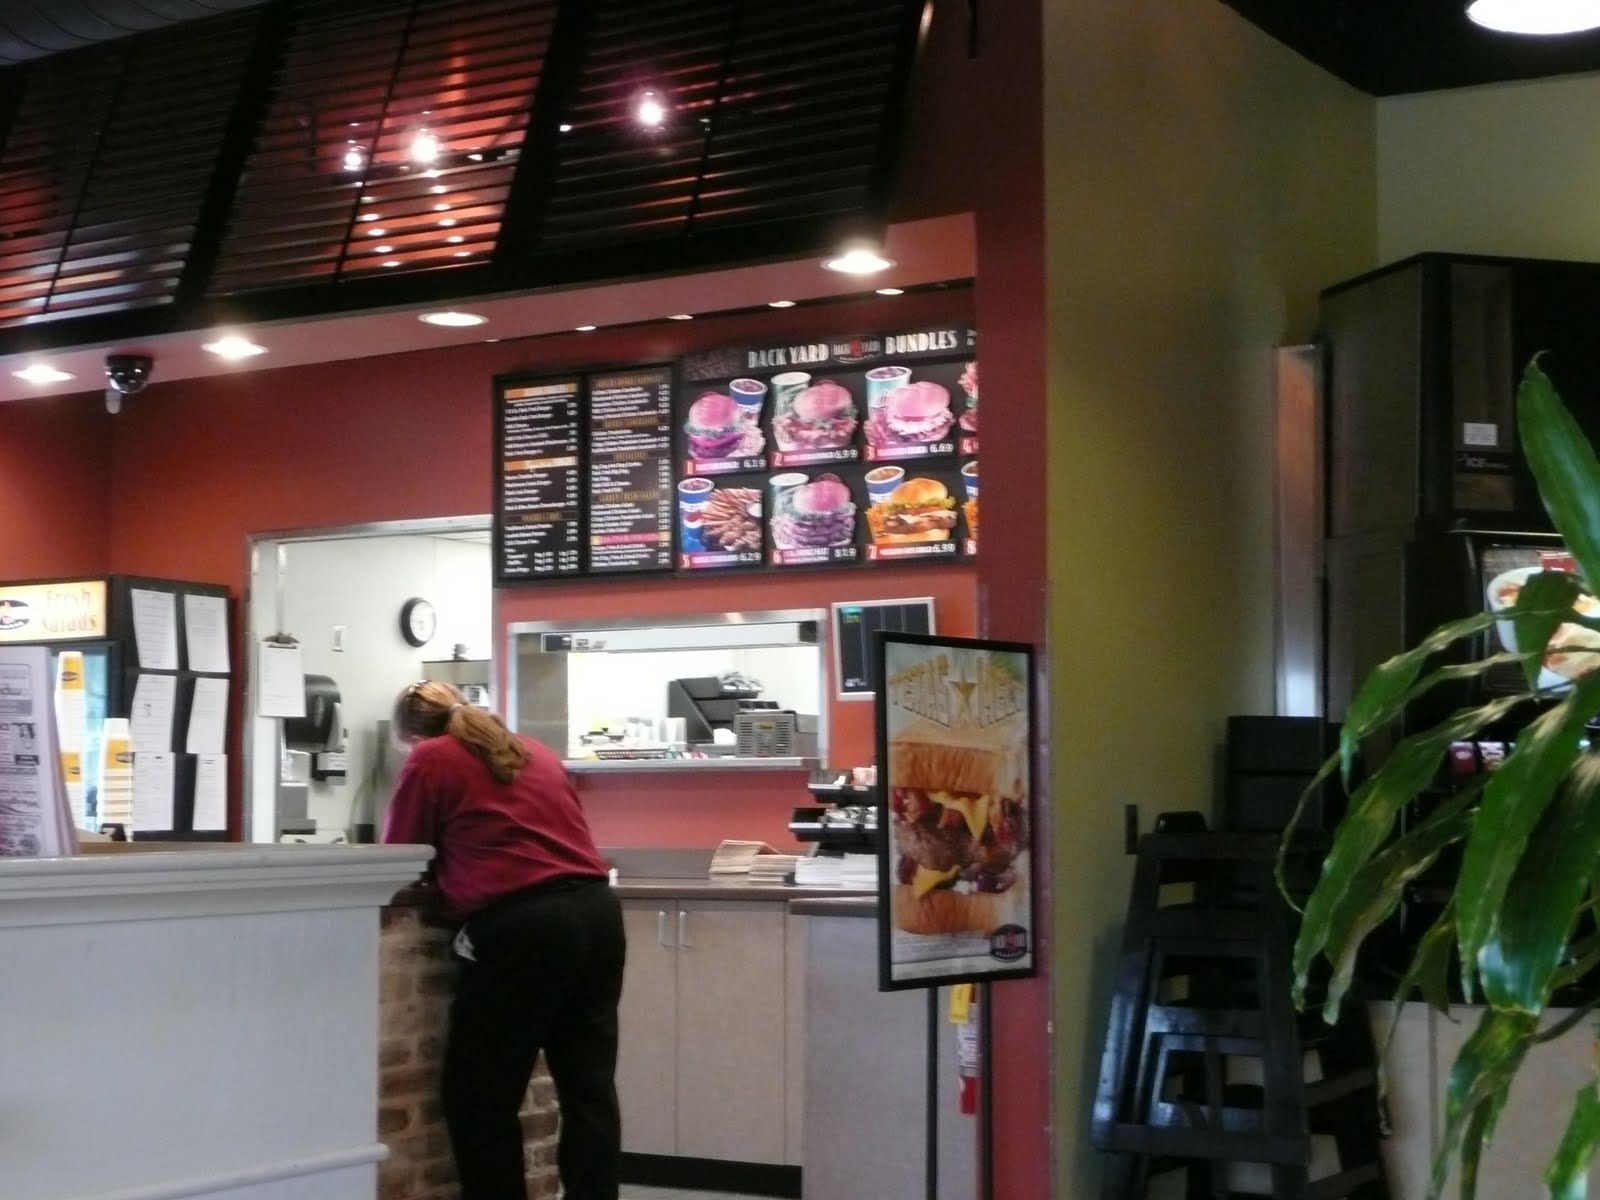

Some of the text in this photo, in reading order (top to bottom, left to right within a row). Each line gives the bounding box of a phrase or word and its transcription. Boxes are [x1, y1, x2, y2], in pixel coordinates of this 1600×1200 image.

[885, 329, 958, 355] BUNDLES
[747, 343, 830, 368] BACK YARD
